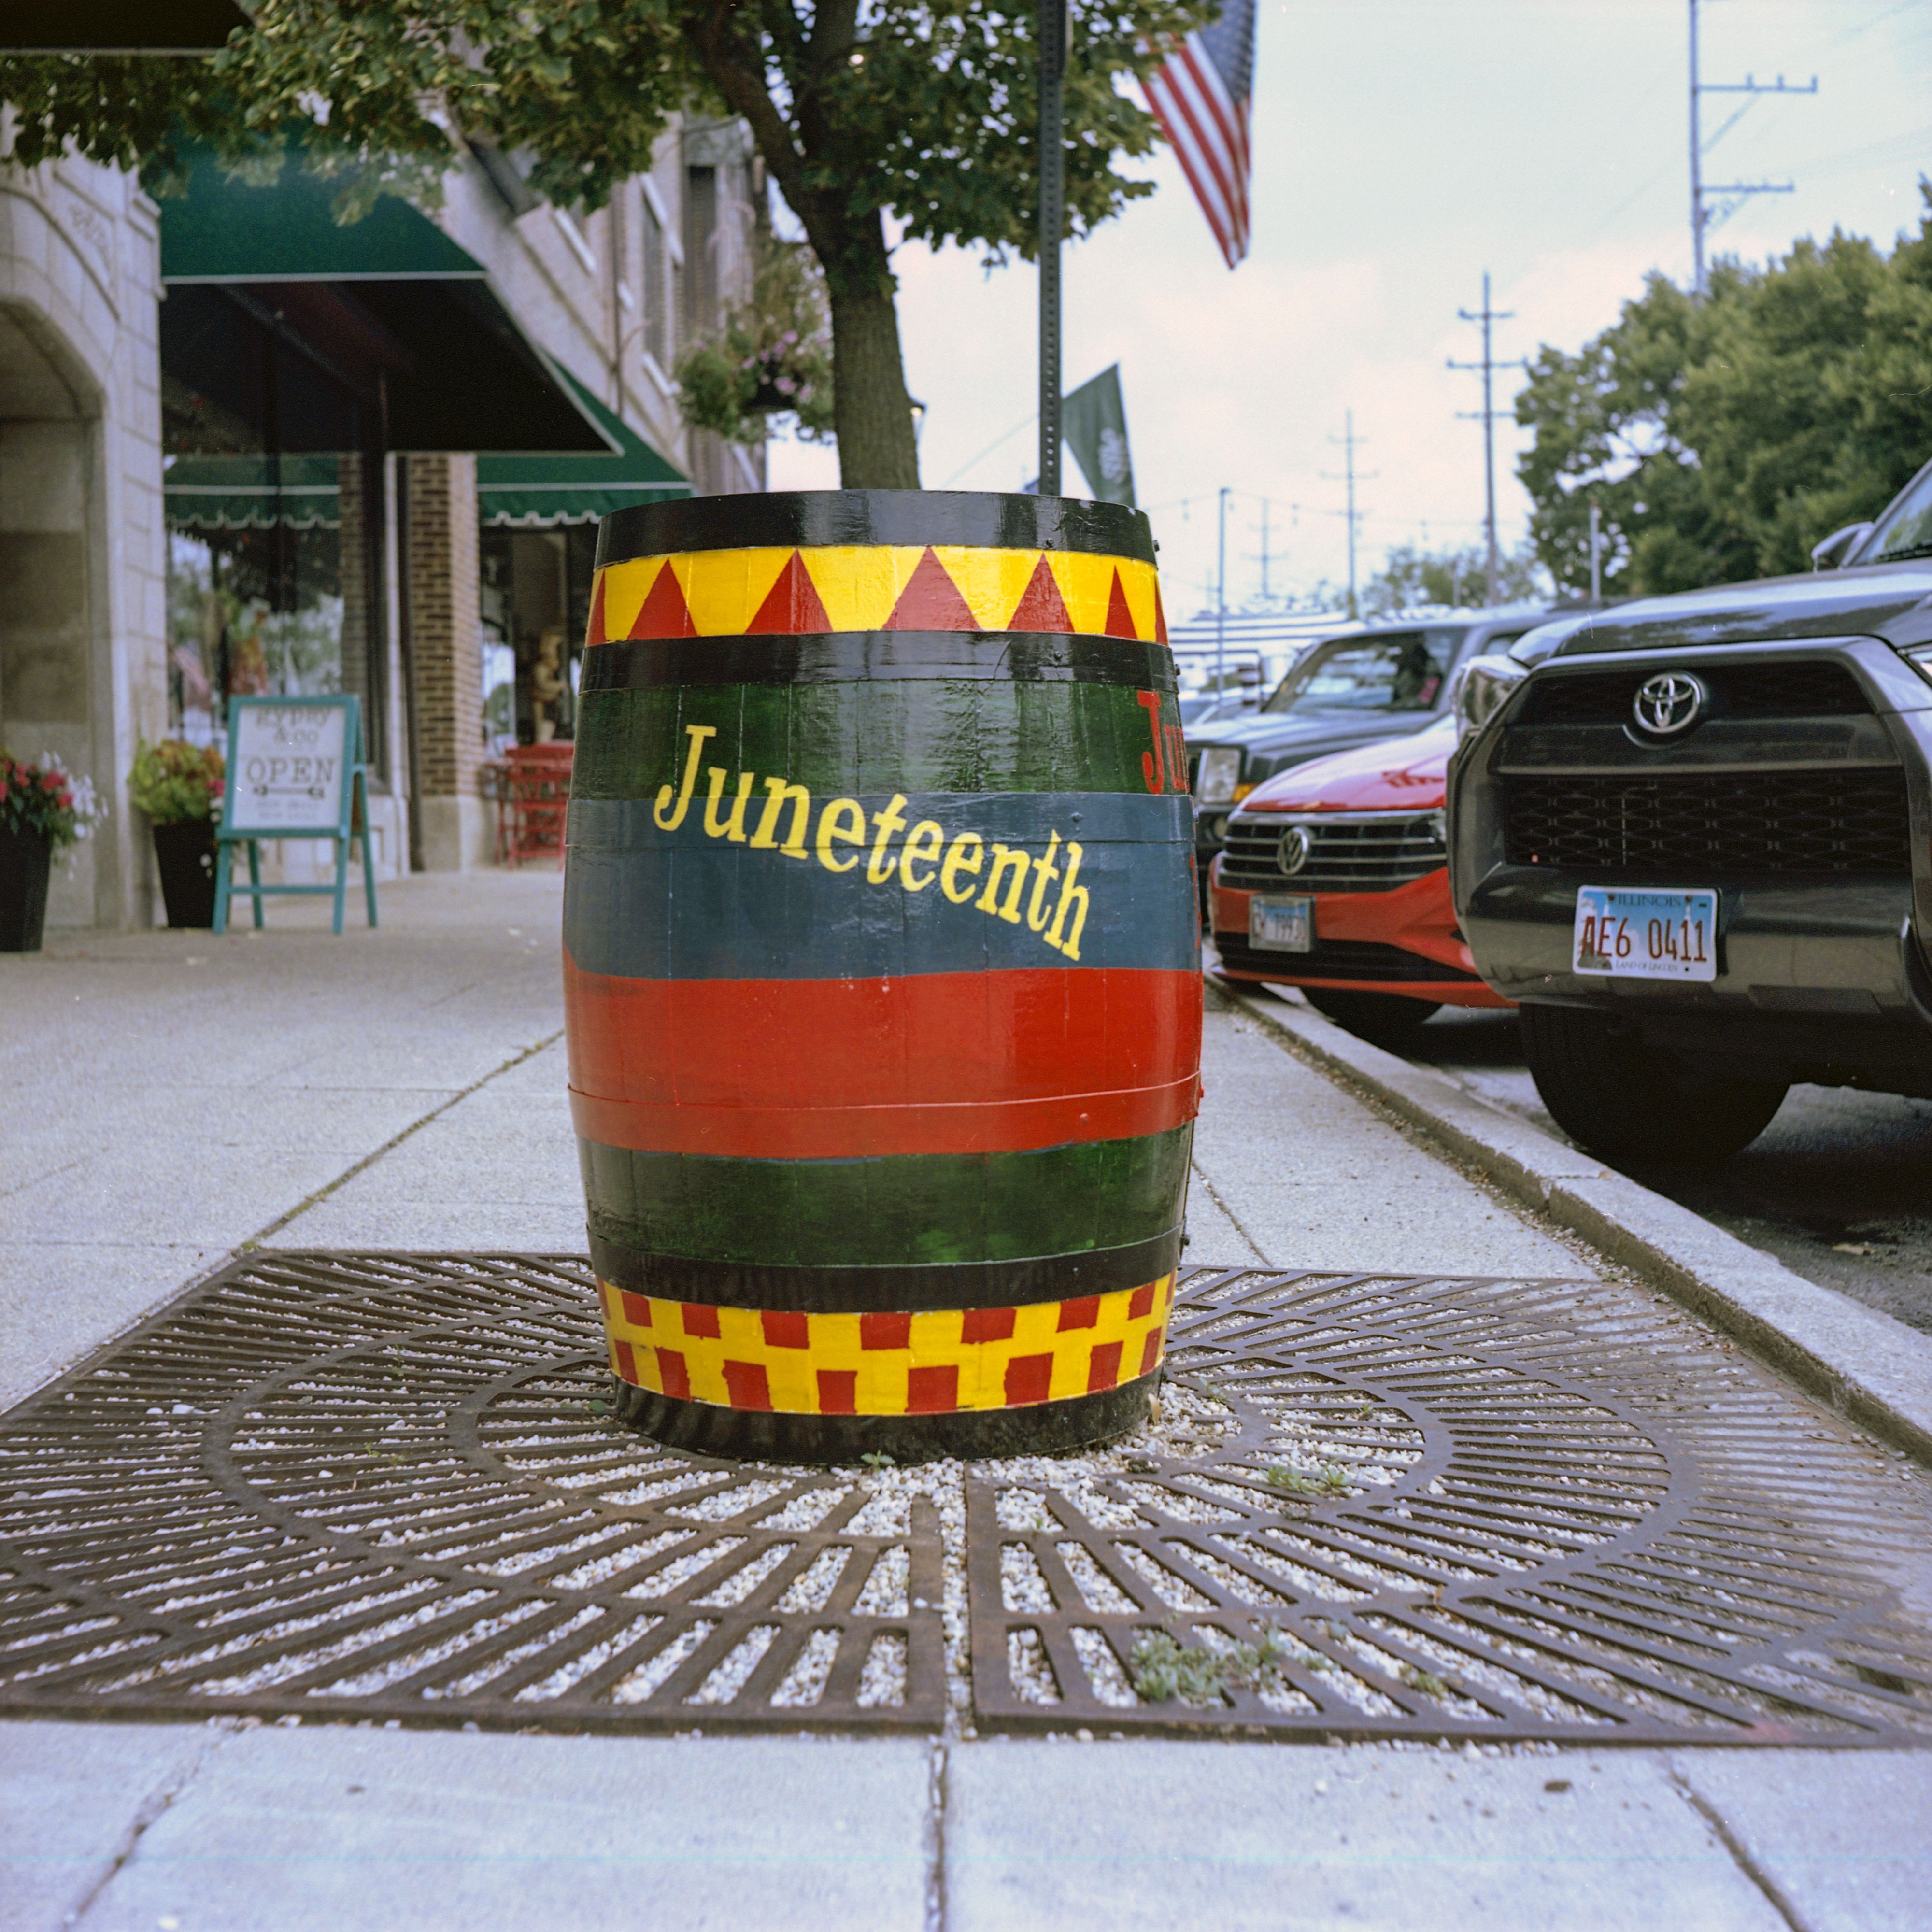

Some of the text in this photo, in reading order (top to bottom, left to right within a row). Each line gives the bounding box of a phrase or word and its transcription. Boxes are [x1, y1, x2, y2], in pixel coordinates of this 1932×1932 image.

[246, 756, 335, 783] OPEN
[653, 725, 1090, 961] Juneteenth
[1618, 895, 1682, 907] ILLINOIS
[1580, 916, 1707, 963] AE6 0411
